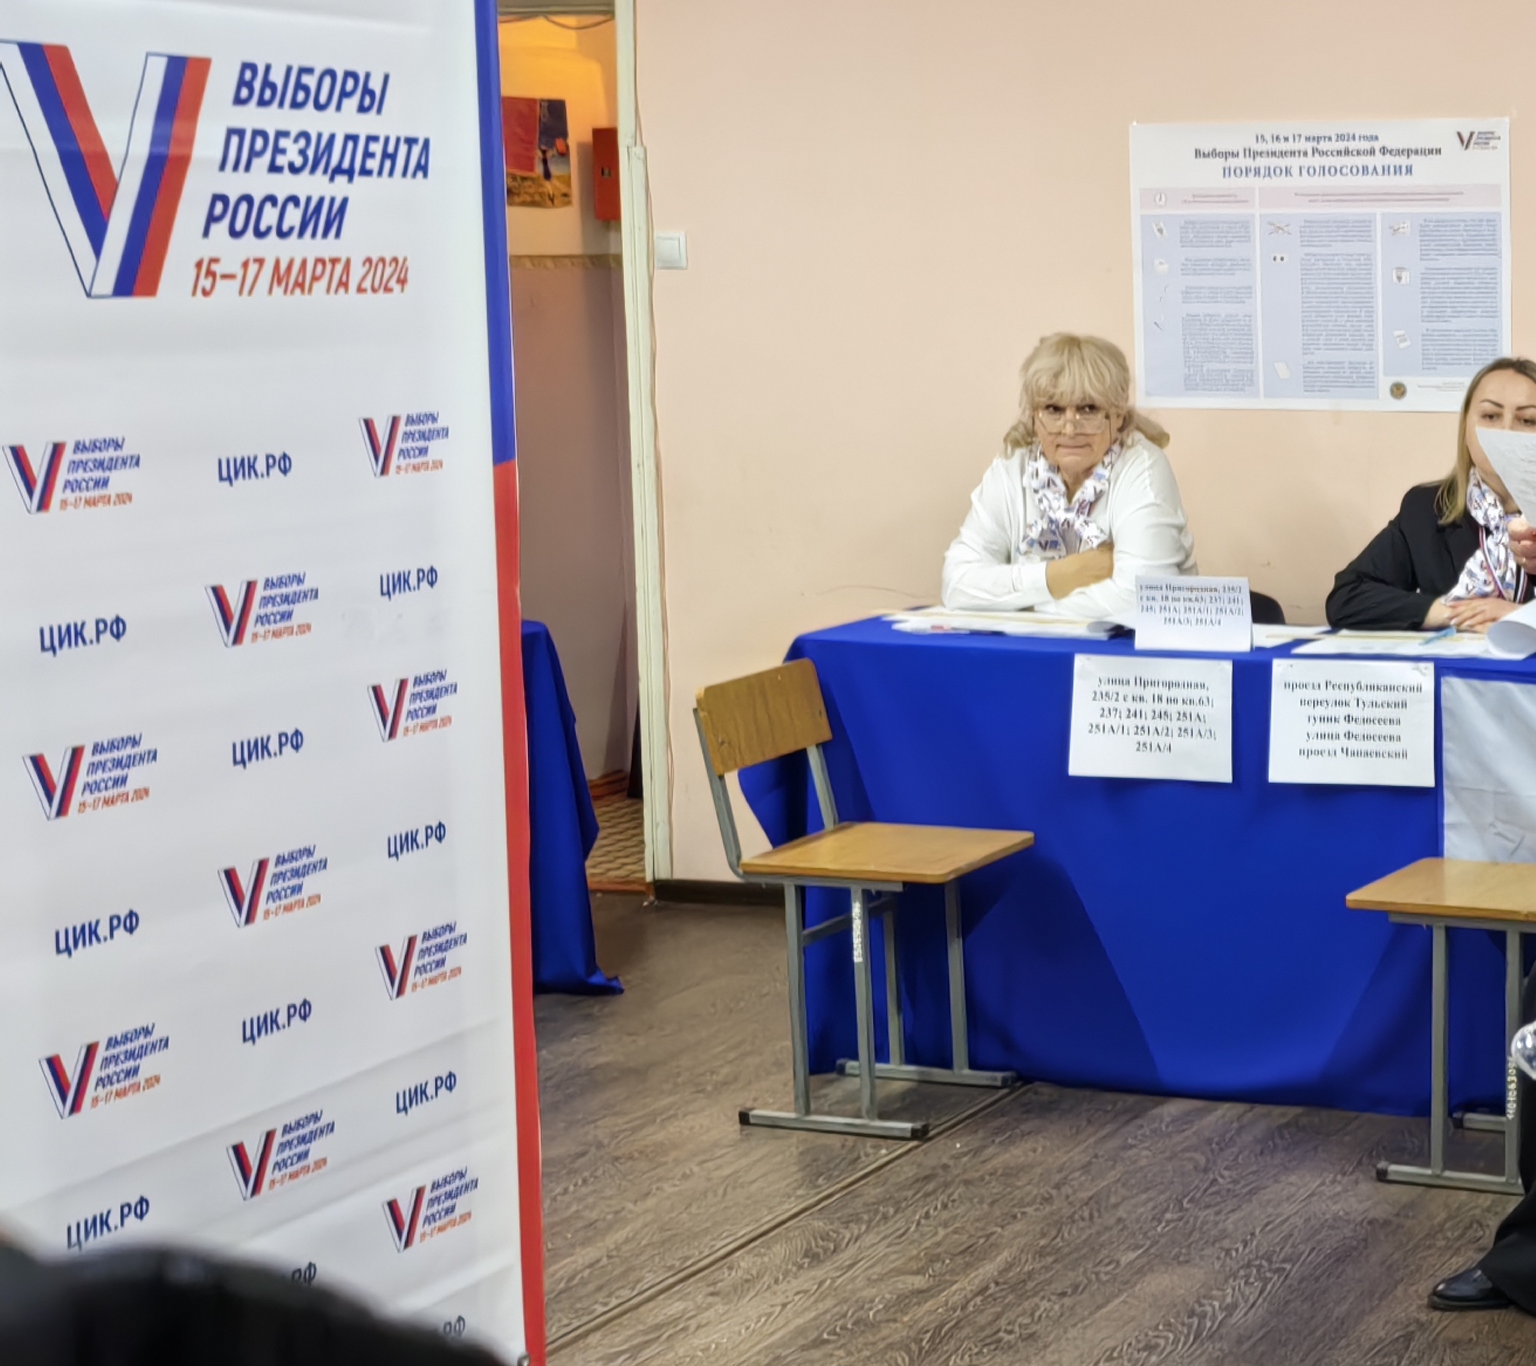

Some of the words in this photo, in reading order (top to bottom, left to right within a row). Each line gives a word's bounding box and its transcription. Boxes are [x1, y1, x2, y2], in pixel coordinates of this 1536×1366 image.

[232, 61, 390, 116] ВЫБОРЫ
[218, 127, 431, 184] ПРЕЗИДЕНТА
[1194, 147, 1239, 162] Выборы
[1243, 147, 1308, 160] Президента
[1312, 145, 1375, 158] Российской
[1379, 145, 1442, 159] Федерации
[1222, 165, 1293, 180] ПОРЯДОК
[1299, 164, 1413, 178] ГОЛОСОВАНИЯ
[202, 193, 349, 240] РОССИИ
[268, 257, 352, 296] МАРТА
[356, 256, 409, 294] 2024
[73, 436, 125, 455] ВЫБОРЫ
[67, 453, 140, 475] ПРЕЗИДЕНТА
[218, 452, 292, 486] ЦИК.РФ
[62, 476, 110, 494] РОССИИ
[380, 565, 438, 600] ЦИК.РФ
[39, 613, 127, 656] ЦИК.РФ
[1299, 698, 1350, 710] переулок
[1354, 697, 1408, 711] Тульский
[1325, 680, 1422, 694] Республиканский
[91, 731, 142, 756] ВЫБОРЫ
[232, 728, 304, 769] ЦИК.РФ
[1305, 731, 1340, 742] улица
[86, 747, 158, 777] ПРЕЗИДЕНТА
[81, 773, 128, 797] РОССИИ
[387, 820, 447, 861] ЦИК.РФ
[54, 908, 140, 958] ЦИК.РФ
[105, 1022, 156, 1052] ВЫБОРЫ
[241, 998, 313, 1046] ЦИК.РФ
[99, 1035, 170, 1071] ПРЕЗИДЕНТА
[94, 1063, 141, 1092] РОССИИ
[396, 1070, 458, 1117] ЦИК.РФ
[66, 1194, 151, 1253] ЦИК.РФ
